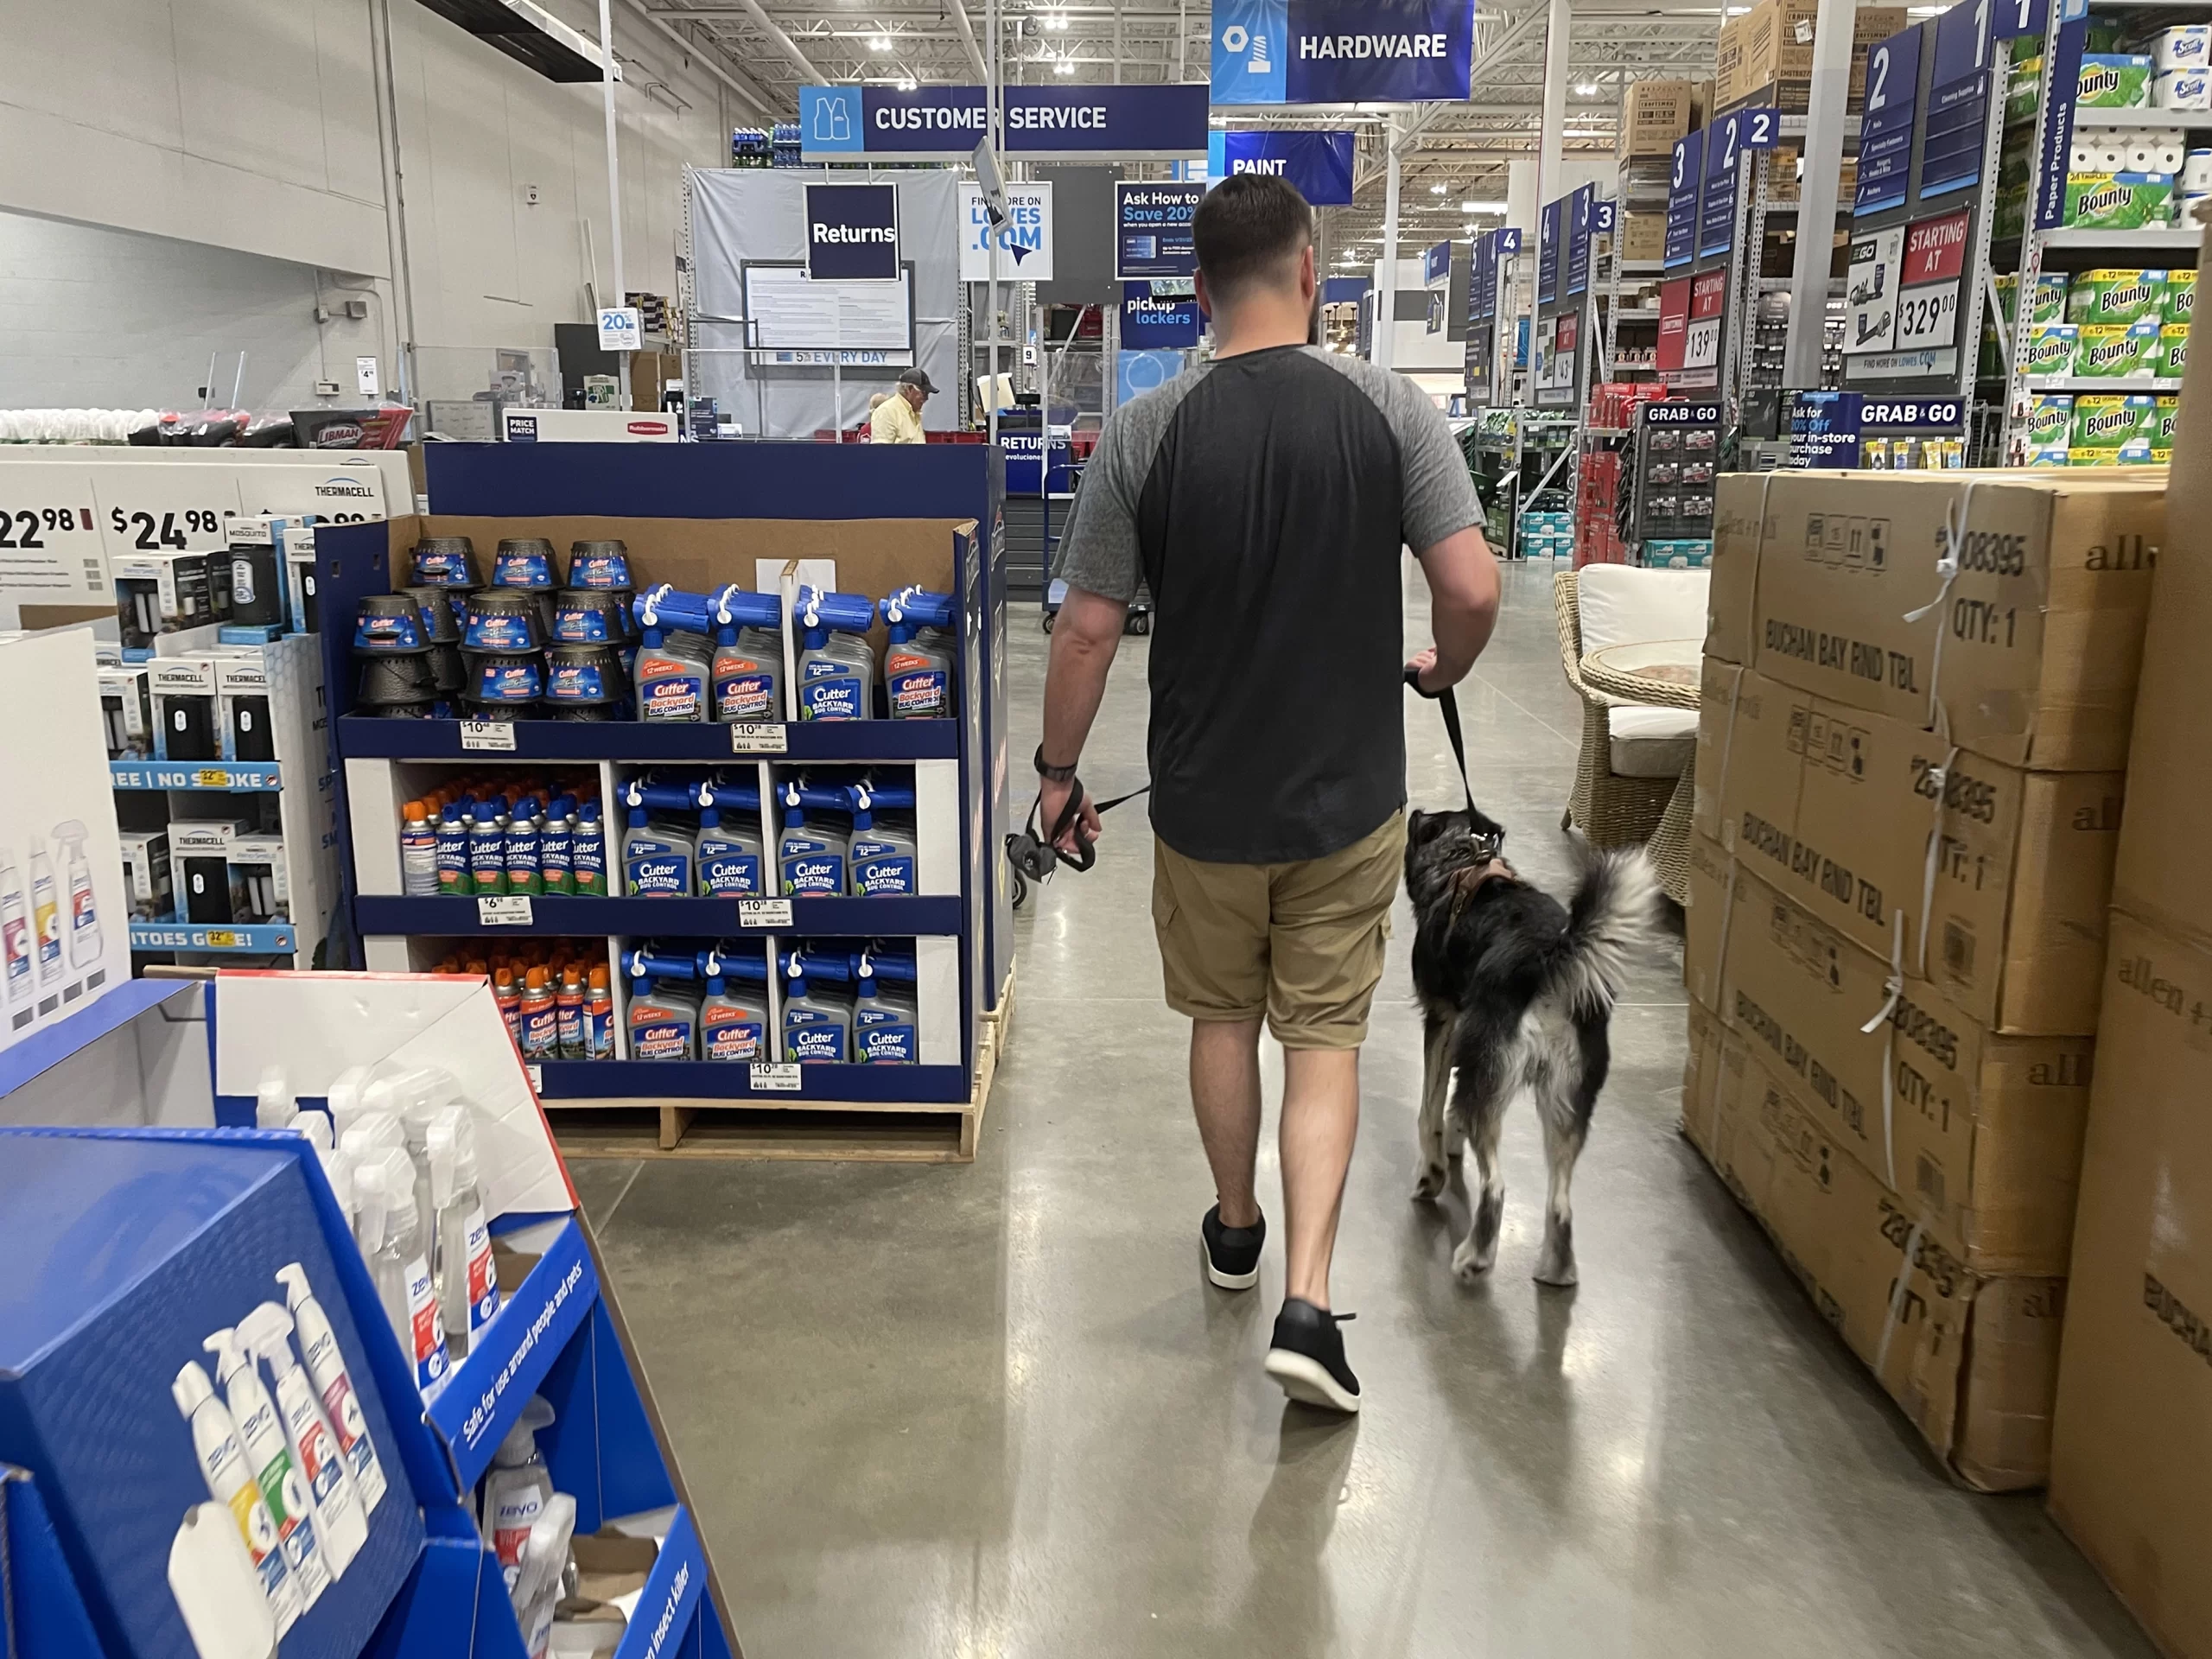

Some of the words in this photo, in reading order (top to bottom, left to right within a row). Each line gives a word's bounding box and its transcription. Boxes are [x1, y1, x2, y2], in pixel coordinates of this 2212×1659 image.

[1300, 34, 1447, 60] HARDWARE
[1869, 47, 1889, 111] 2
[875, 107, 1000, 129] CUSTOMER
[1009, 107, 1107, 129] SERVICE
[1751, 114, 1770, 143] 2
[2050, 102, 2068, 170] Products
[1723, 118, 1737, 169] 2
[1233, 159, 1287, 176] PAINT
[1673, 143, 1685, 189] 3
[971, 196, 988, 206] FIN
[1007, 197, 1026, 206] ORE
[1027, 197, 1041, 206] ON
[1123, 192, 1148, 205] Ask
[1152, 192, 1182, 205] How
[1185, 193, 1199, 205] to
[2045, 175, 2059, 220] Paper
[2078, 186, 2132, 216] Bounty
[1123, 207, 1163, 220] Save
[1581, 188, 1591, 226] 3
[1598, 206, 1612, 228] 3
[813, 224, 895, 243] Returns
[1542, 208, 1550, 244] 4
[1503, 232, 1516, 249] 4
[1910, 220, 1963, 252] STARTING
[1472, 242, 1478, 270] 5
[1925, 250, 1942, 272] AT
[1694, 277, 1723, 297] STARTING
[1128, 296, 1175, 314] pickup
[1703, 296, 1712, 313] AT
[2101, 284, 2151, 311] Bounty
[1136, 312, 1191, 325] lockers
[862, 352, 887, 363] DAY
[1026, 350, 1033, 359] 9
[2029, 340, 2071, 364] Bounty
[2089, 340, 2139, 366] Bounty
[1864, 359, 1875, 368] FIND
[1876, 359, 1890, 369] MORE
[1891, 359, 1897, 367] ON
[1649, 408, 1689, 421] GRAB
[1697, 408, 1717, 421] GO
[1792, 407, 1805, 417] Ask
[1807, 406, 1822, 418] for
[1861, 404, 1917, 423] GRAB
[1919, 409, 1926, 417] &
[1929, 404, 1956, 423] GO
[511, 419, 534, 428] PRICE
[2029, 410, 2068, 433] Bounty
[2087, 410, 2135, 436] Bounty
[318, 428, 360, 443] LIBMAN
[1001, 436, 1066, 449] RETURNS
[1808, 431, 1855, 443] in-store
[315, 486, 374, 498] THERMACELL
[1954, 598, 1999, 645] QTY:
[2006, 607, 2016, 648] 1
[1766, 619, 1815, 663] BUCHAN
[1819, 633, 1847, 671] BAY
[1888, 651, 1919, 694] TBL
[158, 673, 204, 683] THERMACELL
[902, 677, 934, 691] Cutter
[654, 682, 690, 696] Cutter
[728, 680, 761, 695] Cutter
[815, 688, 851, 702] Cutter
[899, 687, 940, 702] Backyard
[651, 694, 694, 708] Backyard
[725, 691, 766, 706] Backyard
[737, 701, 766, 711] CONTROL
[812, 701, 854, 710] BACKYARD
[664, 703, 693, 714] CONTROL
[158, 772, 187, 787] NO
[191, 773, 262, 787] SOKE
[640, 864, 677, 877] Cutter
[712, 864, 748, 877] Cutter
[796, 863, 832, 877] Cutter
[867, 866, 903, 880] Cutter
[639, 876, 679, 885] BACKYARD
[710, 876, 751, 885] BACKYARD
[794, 876, 835, 886] BACKYARD
[865, 878, 906, 887] BACKYARD
[130, 932, 188, 946] ITOES
[193, 933, 252, 947] GE!
[2119, 956, 2184, 1016] allen
[645, 1028, 677, 1040] Cutter
[718, 1029, 750, 1041] Cutter
[798, 1033, 834, 1046] Cutter
[869, 1033, 904, 1046] Cutter
[642, 1037, 683, 1051] Backyard
[715, 1038, 755, 1052] Backyard
[797, 1045, 836, 1053] BACKYARD
[868, 1045, 906, 1054] BACKYARD
[1898, 1061, 1936, 1122] QTY:
[1942, 1098, 1950, 1133] 1
[463, 1409, 484, 1442] Safe
[482, 1386, 496, 1416] for
[495, 1370, 510, 1396] use
[509, 1331, 532, 1376] around
[531, 1301, 556, 1344] people
[554, 1280, 568, 1308] and
[566, 1259, 583, 1294] pets
[651, 1605, 677, 1651] insect
[671, 1560, 690, 1605] killer
